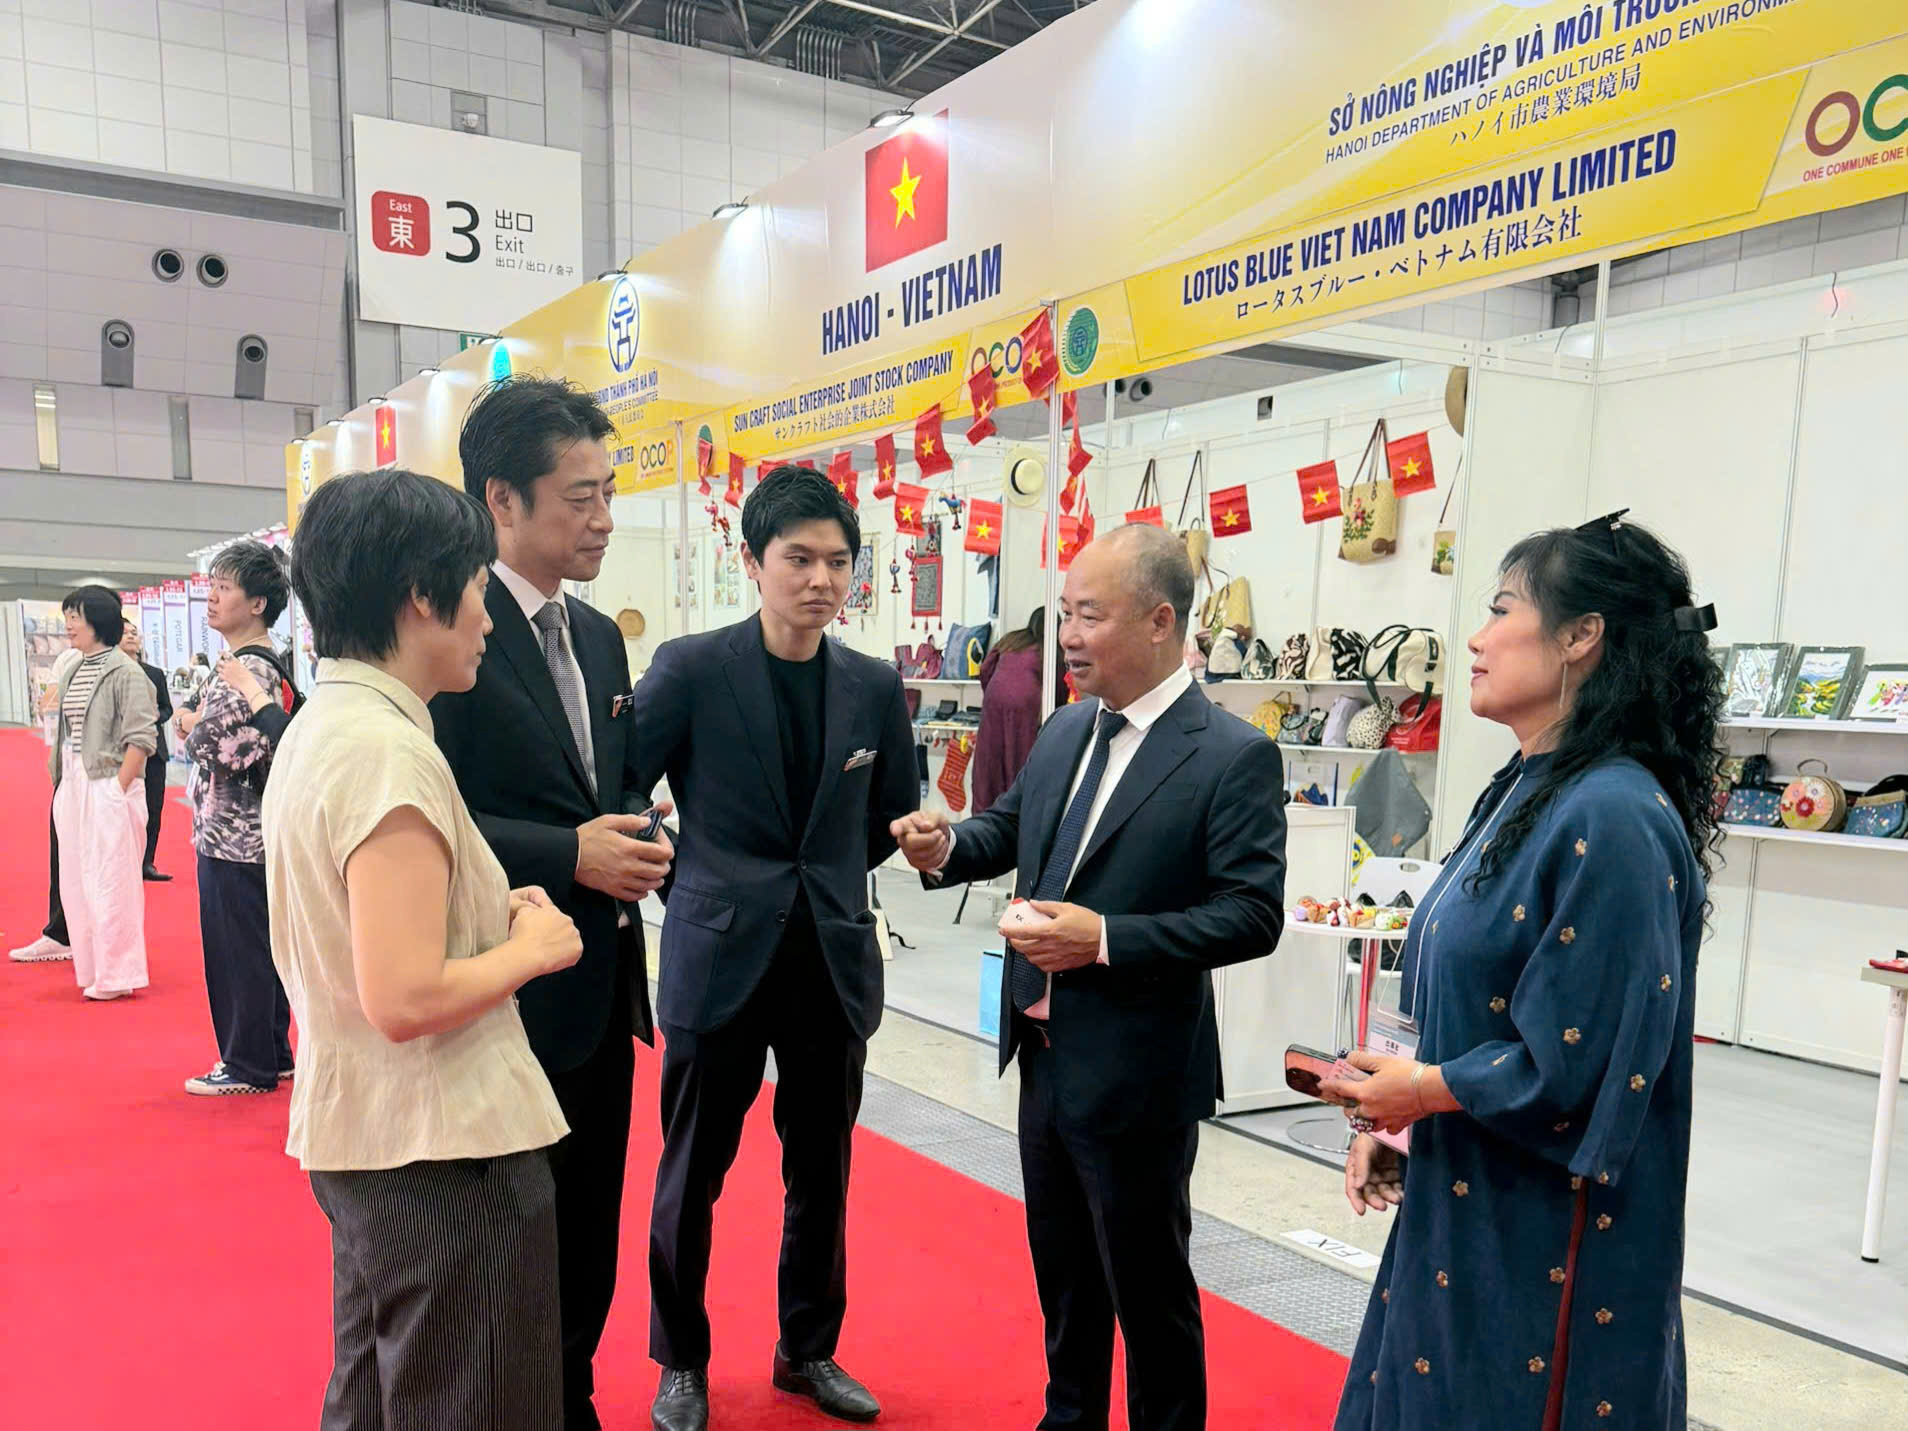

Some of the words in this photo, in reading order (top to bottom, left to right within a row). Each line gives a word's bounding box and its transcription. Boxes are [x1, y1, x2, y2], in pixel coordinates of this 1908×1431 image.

[1326, 136, 1368, 164] HANOI
[1371, 98, 1472, 148] DEPARTMENT
[1476, 89, 1498, 111] OF
[1502, 43, 1626, 102] AGRICULTURE
[1631, 27, 1672, 57] AND
[1329, 92, 1355, 136] SỞ
[1360, 77, 1417, 125] NÔNG
[1423, 43, 1506, 102] NGHIỆP
[1516, 23, 1544, 68] VÀ
[1553, 4, 1604, 54] MÔI
[1450, 63, 1641, 145] ハノイ市農業環境局
[1803, 166, 1825, 182] ONE
[1826, 153, 1879, 176] COMMUNE
[1881, 147, 1904, 163] ONE
[388, 216, 415, 249] 東
[389, 199, 413, 214] East
[445, 201, 481, 263] 3
[495, 209, 533, 232] 出口
[1184, 259, 1240, 305] LOTUS
[1245, 242, 1294, 287] BLUE
[1301, 227, 1346, 272] VIET
[1352, 208, 1406, 257] NAM
[1414, 167, 1544, 240] COMPANY
[1552, 128, 1677, 201] LIMITED
[495, 235, 524, 254] Exit
[495, 256, 515, 268] 出口
[526, 260, 546, 273] 出口
[823, 292, 880, 355] HANOI
[902, 243, 1002, 328] VIETNAM
[734, 412, 748, 432] SUN
[750, 405, 771, 428] CRAFT
[772, 399, 798, 422] SOCIAL
[800, 382, 846, 413] ENTERPRISE
[848, 375, 872, 399] JOINT
[875, 365, 904, 393] STOCK
[906, 350, 954, 383] COMPANY
